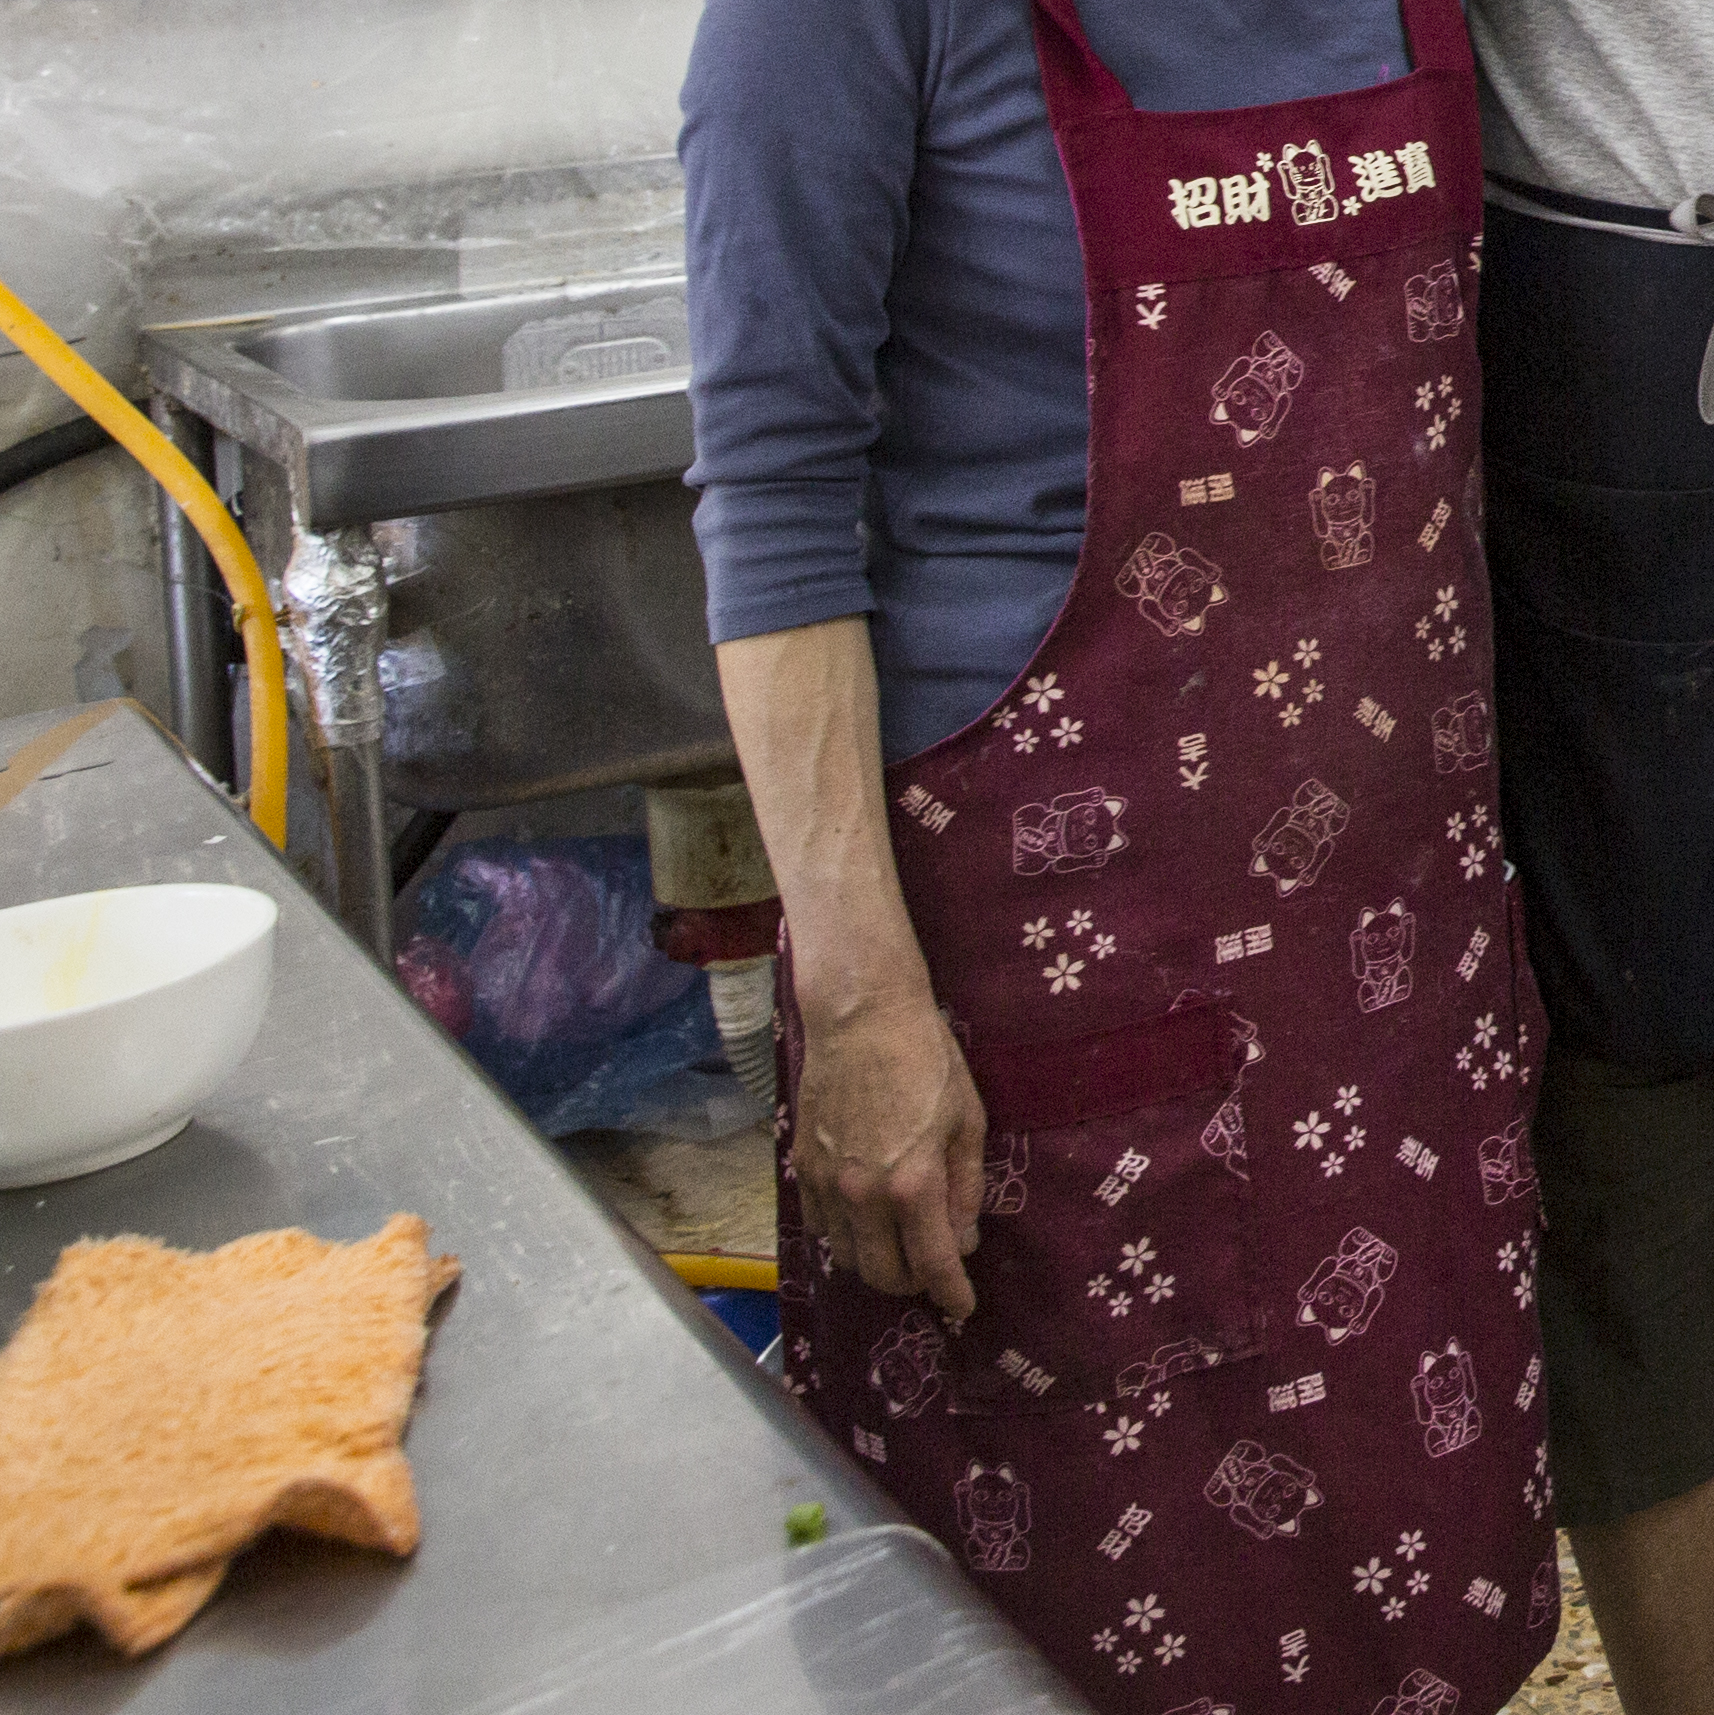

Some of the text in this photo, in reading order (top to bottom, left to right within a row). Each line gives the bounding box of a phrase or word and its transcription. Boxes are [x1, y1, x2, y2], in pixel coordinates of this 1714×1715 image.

[1167, 140, 1438, 232] 招財 進寶
[1095, 1146, 1152, 1208] 招財
[1096, 1501, 1154, 1562] 招財
